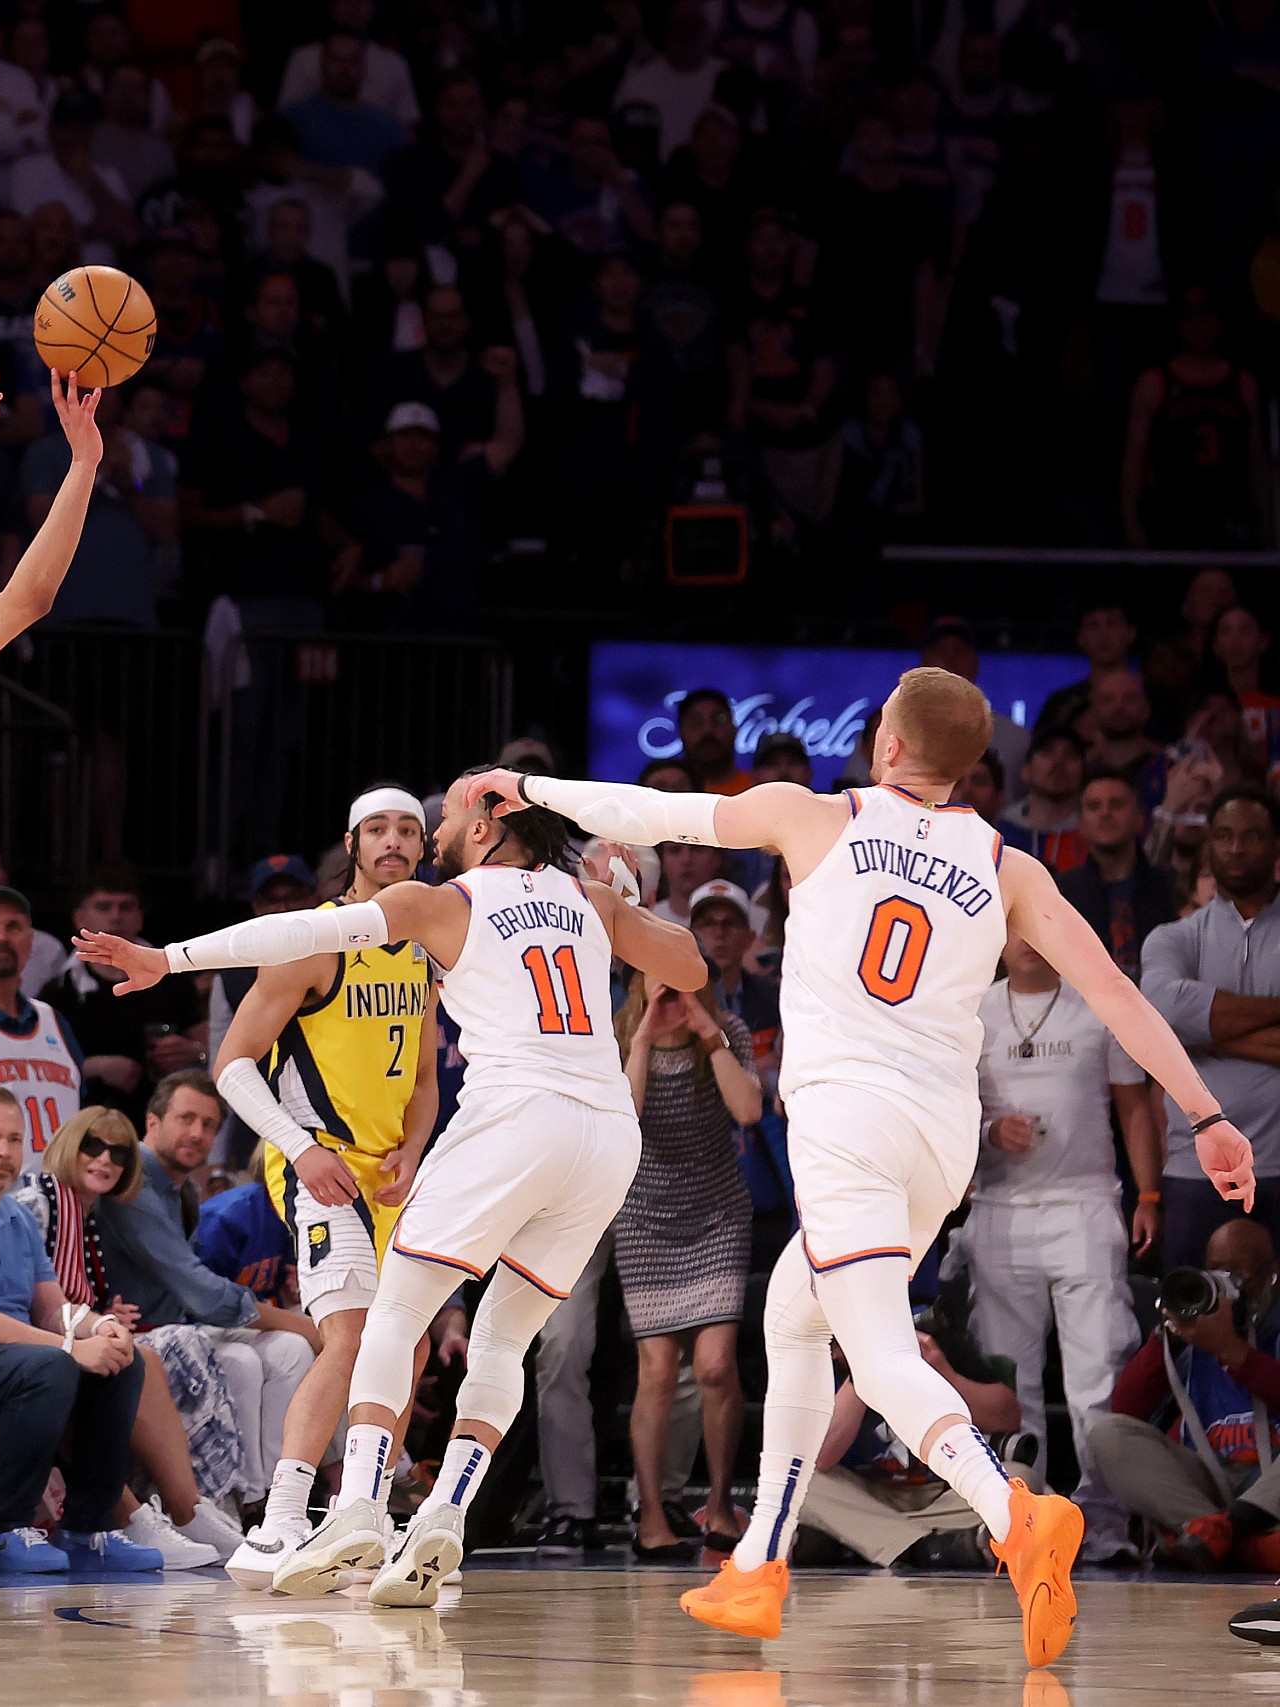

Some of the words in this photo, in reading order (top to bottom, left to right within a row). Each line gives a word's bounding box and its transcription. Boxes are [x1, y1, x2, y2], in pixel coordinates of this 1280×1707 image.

[849, 838, 993, 917] DIVINCENZO
[487, 901, 584, 940] BRUNSON
[857, 894, 933, 1006] 0
[521, 945, 594, 1035] 11
[28, 1058, 76, 1089] YORK
[385, 1023, 406, 1078] 2
[25, 1096, 63, 1153] 11
